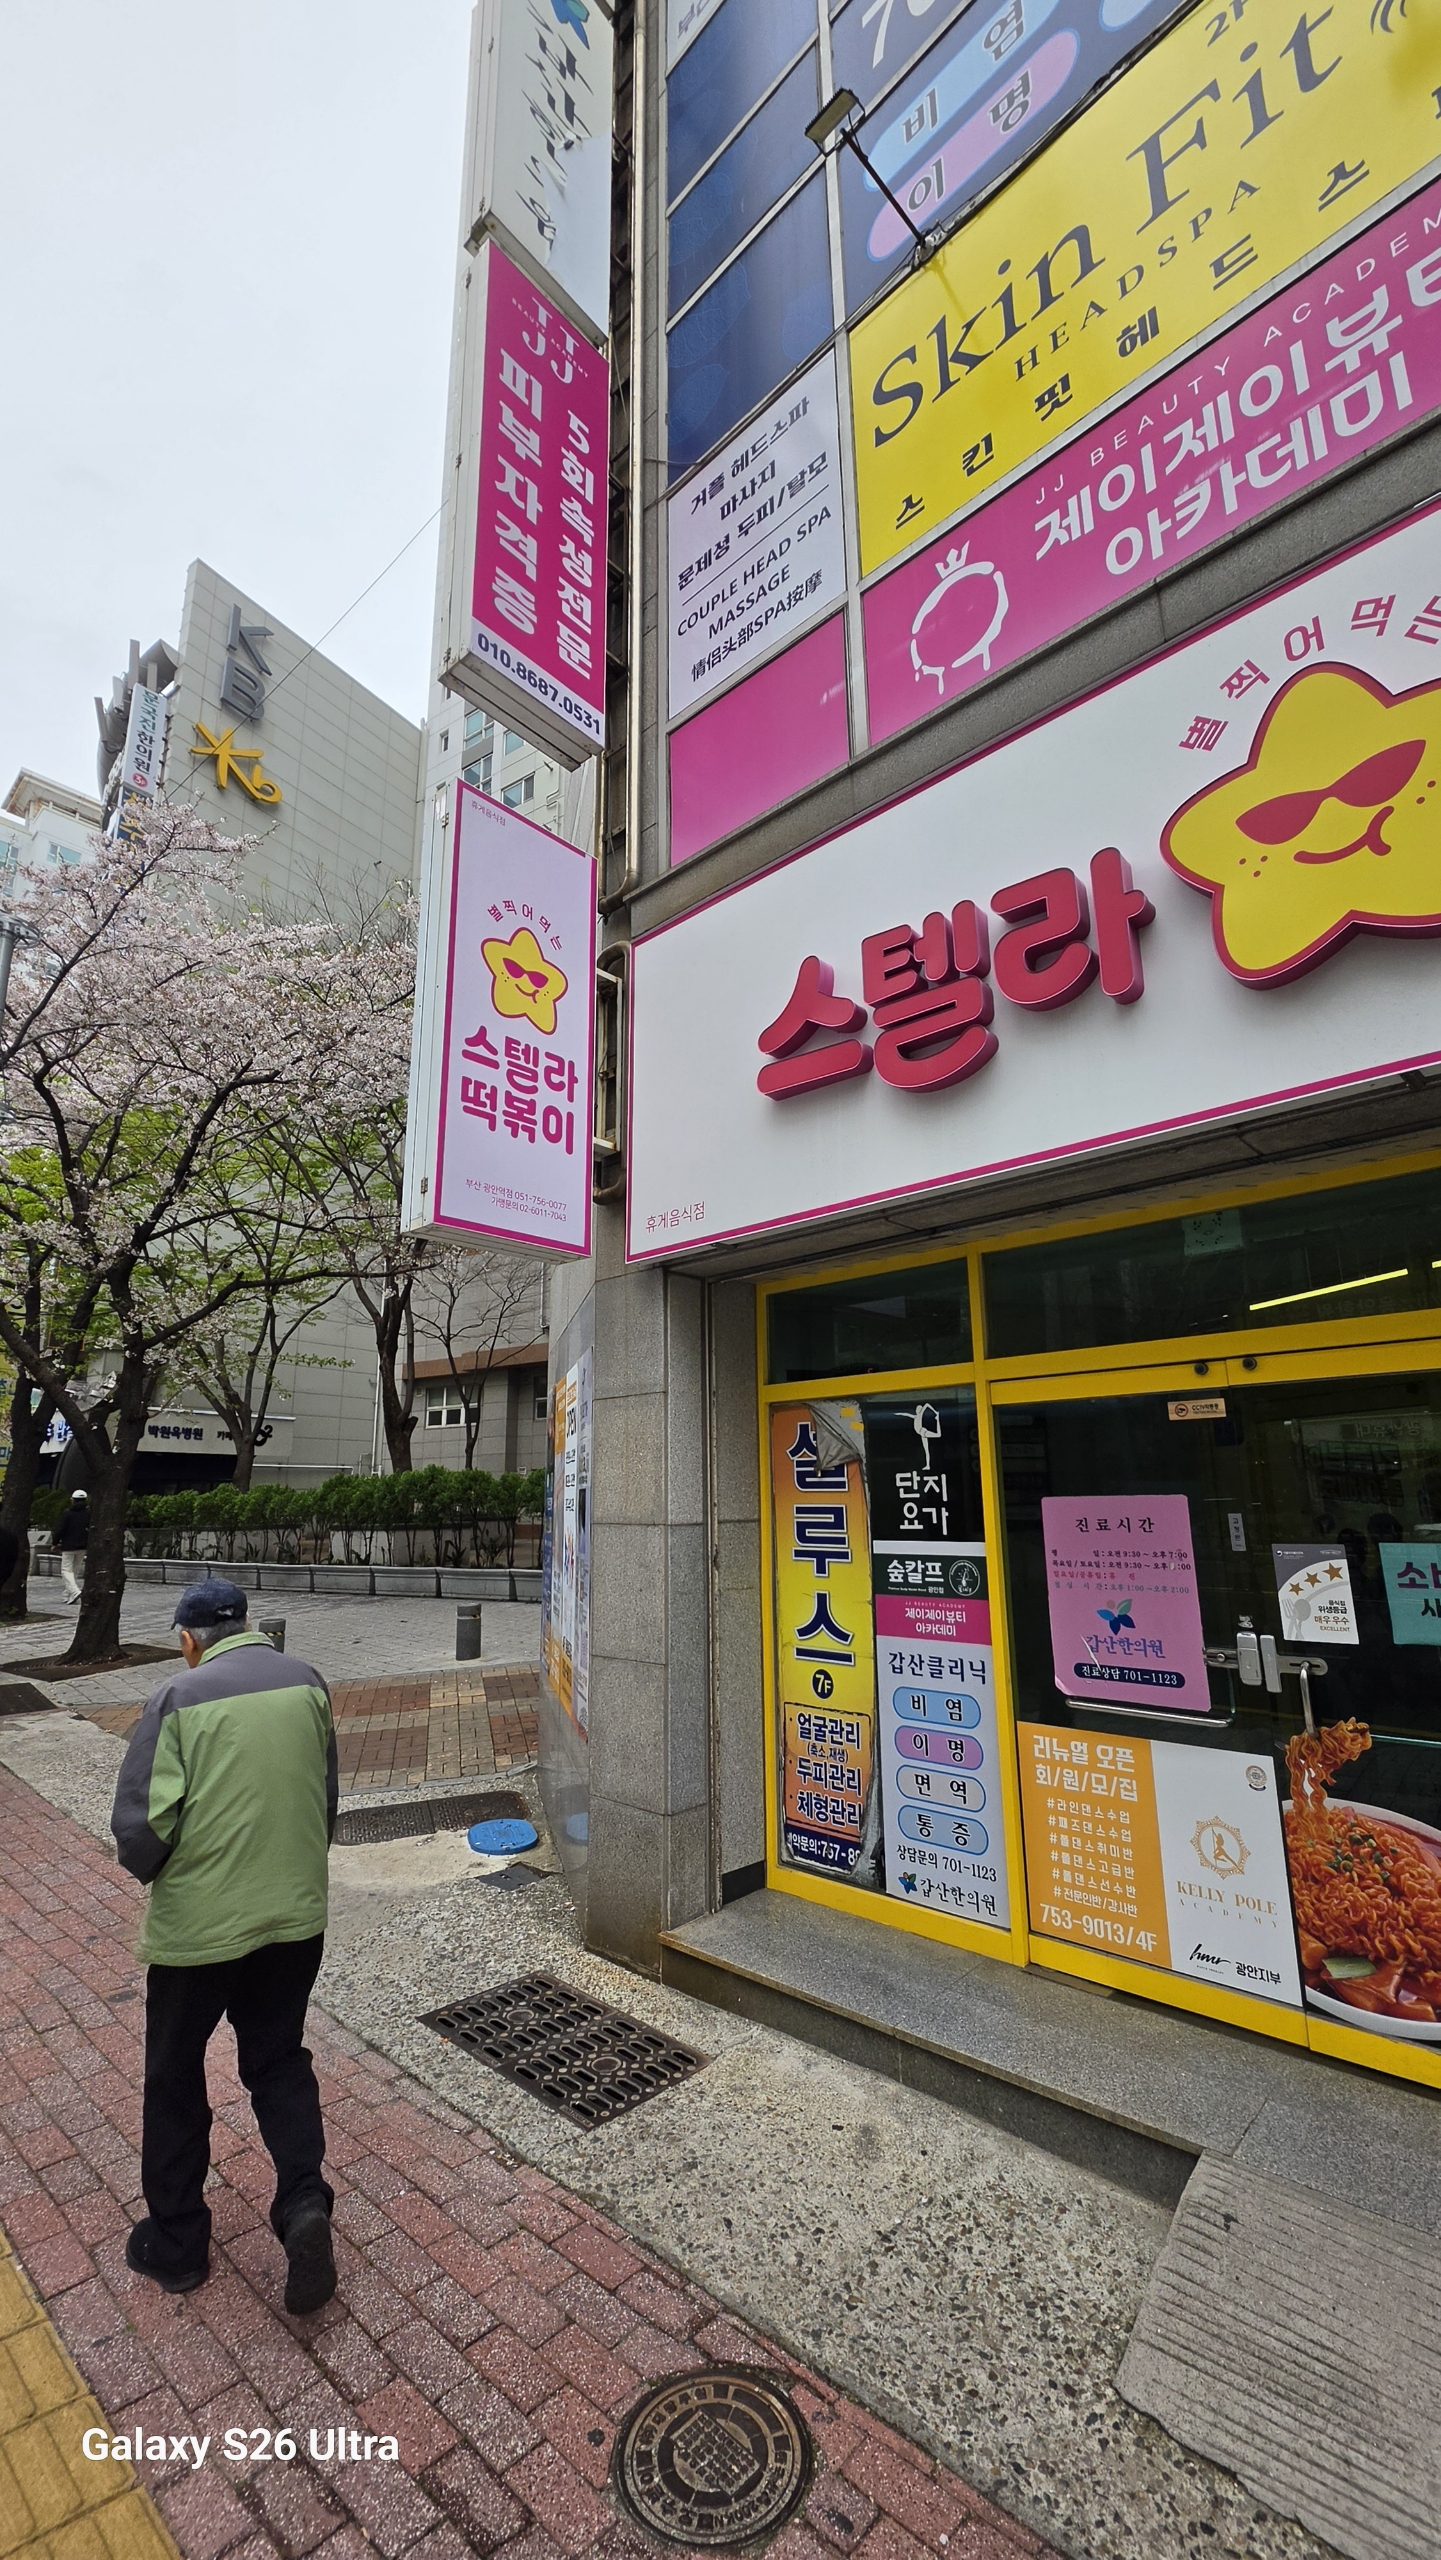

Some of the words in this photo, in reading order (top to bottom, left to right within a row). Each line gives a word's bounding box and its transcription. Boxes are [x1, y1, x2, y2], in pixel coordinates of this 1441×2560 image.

[872, 223, 1106, 448] Skin
[1125, 4, 1343, 236] Fit
[730, 396, 810, 481] 헤드스파
[1034, 473, 1066, 505] JJ
[1089, 356, 1231, 467] BEAUTY
[1104, 350, 1414, 576] 아카데미
[491, 347, 544, 636] 피부자격증
[719, 458, 777, 521] 마사지
[677, 533, 731, 591] 문제성
[737, 451, 829, 539] 두피/탈모
[677, 577, 738, 637] COUPLE
[742, 536, 792, 588] HEAD
[796, 505, 832, 544] SPA
[708, 563, 791, 640] MASSAGE
[691, 568, 824, 683] 情侣头部SPA按摩
[220, 602, 276, 722] KB
[477, 632, 600, 735] 010.8687.0531
[471, 800, 506, 827] 휴게음식점
[756, 846, 1157, 1102] 스텔라
[461, 1024, 579, 1104] 스텔라
[460, 1075, 575, 1155] 떡볶이
[465, 1178, 482, 1191] 부산
[483, 1182, 513, 1199] 광안역점
[514, 1191, 567, 1211] 051-756-0077
[491, 1196, 519, 1212] 가맹문의
[519, 1204, 567, 1222] 02-6011-7043
[645, 1200, 705, 1234] 휴게음식점
[895, 1470, 948, 1502] 단지
[899, 1501, 949, 1535] 요가
[887, 1559, 944, 1584] 숲칼프
[1107, 1550, 1121, 1558] 오전
[1152, 1551, 1167, 1559] 오후
[1108, 1561, 1122, 1569] 오전
[1153, 1562, 1168, 1570] 오후
[1170, 1586, 1190, 1594] 2:00
[904, 1607, 966, 1624] 제이제이뷰티
[1318, 1606, 1348, 1614] 위생등급
[915, 1622, 957, 1637] 아카데미
[1086, 1634, 1166, 1659] 갑산한의원
[815, 1673, 831, 1695] 7F
[888, 1651, 987, 1685] 갑산클리닉
[1082, 1665, 1121, 1680] 진료상담
[1123, 1670, 1178, 1685] 701-1123
[797, 1711, 861, 1751] 얼굴관리
[807, 1741, 849, 1764] (축소,재생)
[1033, 1735, 1089, 1765] 리뉴얼
[1096, 1744, 1135, 1772] 오픈
[796, 1756, 862, 1797] 두피관리
[797, 1791, 861, 1832] 체형관리
[896, 1844, 938, 1869] 상담문의
[942, 1856, 997, 1882] 701-1123
[920, 1878, 998, 1917] 갑산한의원
[1176, 1880, 1225, 1903] KELLY
[1234, 1893, 1278, 1916] POLE
[1180, 1898, 1277, 1928] ACADEMY
[1039, 1903, 1157, 1952] 753-9013/4F
[1235, 1961, 1281, 1985] 광안지부
